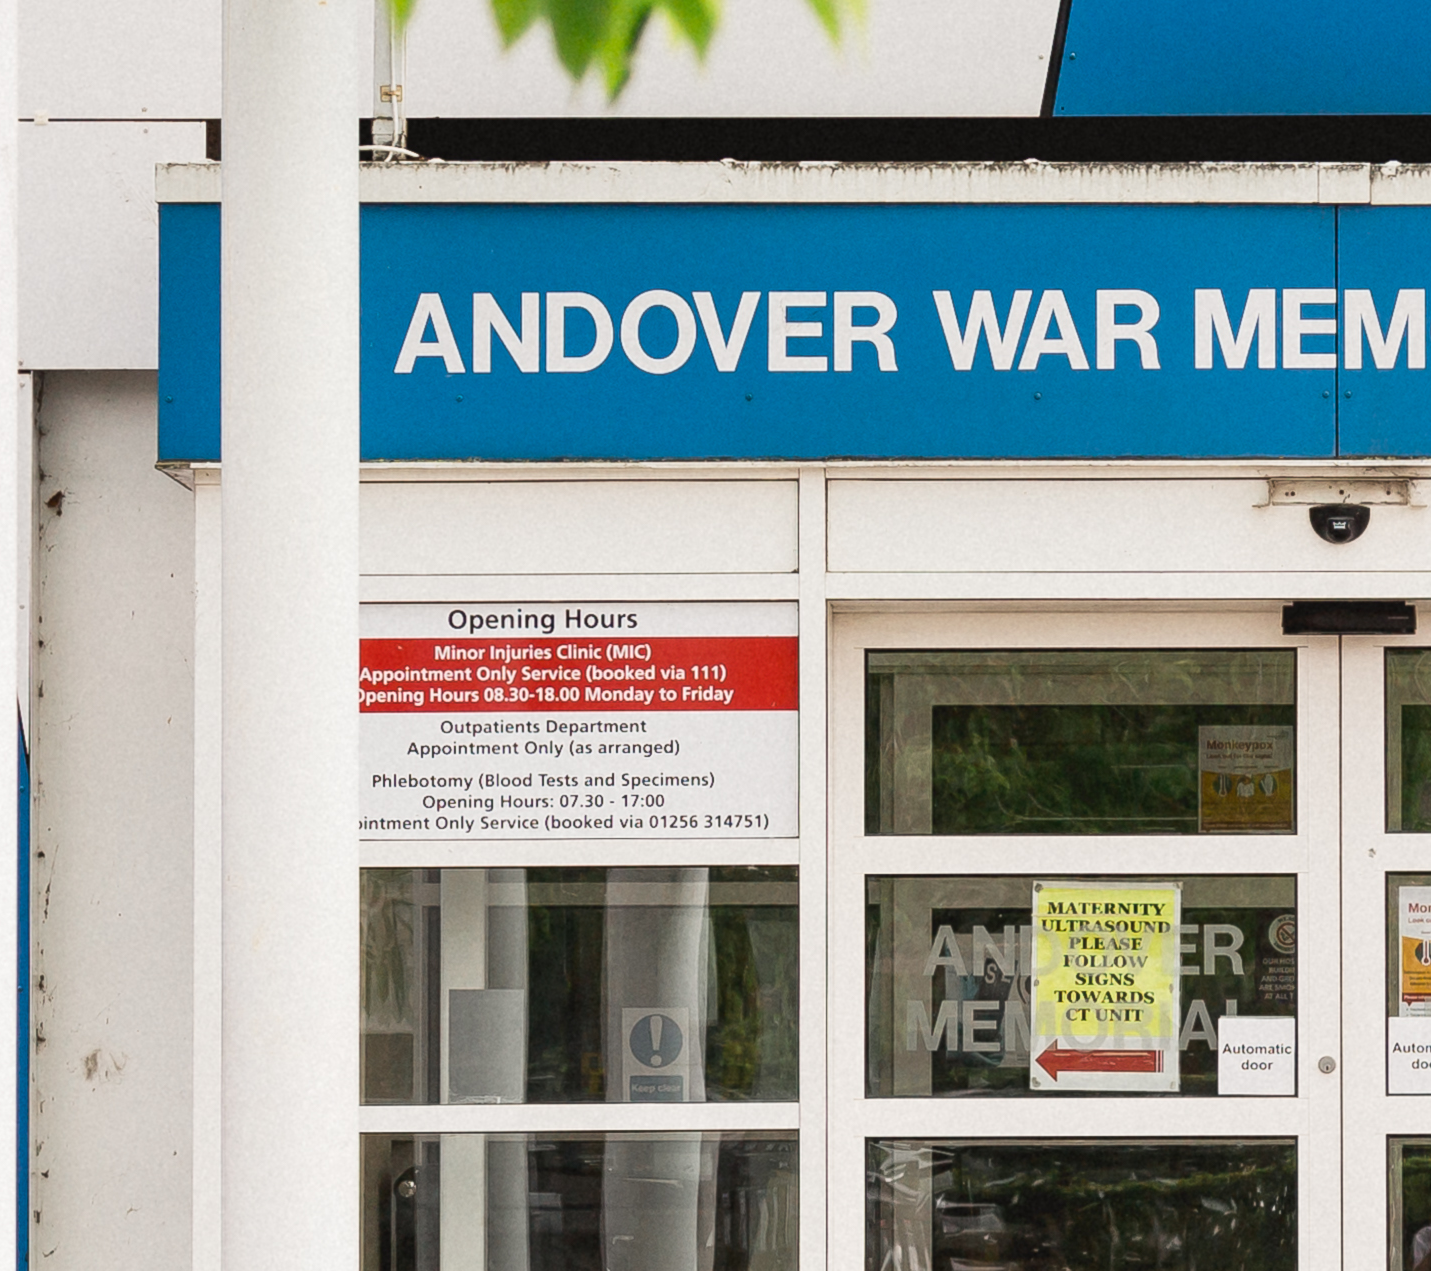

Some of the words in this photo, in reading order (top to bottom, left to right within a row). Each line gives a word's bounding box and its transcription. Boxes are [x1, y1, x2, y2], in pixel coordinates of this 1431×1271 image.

[393, 289, 898, 376] ANDOVER
[933, 289, 1161, 372] WAR
[448, 609, 555, 633] Opening
[565, 609, 638, 629] Hours
[434, 645, 485, 660] Minor
[490, 645, 552, 663] Injuries
[556, 644, 601, 660] Clinic
[606, 644, 651, 662] (MIC)
[360, 666, 472, 685] Appointment
[476, 666, 516, 684] Only
[522, 666, 581, 681] Service
[586, 665, 656, 682] (booked
[660, 665, 685, 680] via
[691, 664, 726, 682] 111)
[429, 688, 479, 702] Hours
[484, 687, 579, 702] 08.30-18.00
[585, 687, 655, 705] Monday
[658, 688, 677, 701] to
[682, 686, 733, 705] Friday
[441, 720, 540, 737] Outpatients
[546, 719, 646, 736] Department
[407, 741, 520, 758] Appointment
[525, 740, 563, 758] Only
[569, 740, 592, 757] (as
[598, 740, 680, 758] arranged)
[1207, 739, 1273, 752] Monkeypox
[372, 774, 473, 792] Phlebotomy
[478, 773, 532, 790] (Blood
[539, 773, 578, 787] Tests
[583, 772, 615, 787] and
[621, 772, 715, 790] Specimens)
[422, 795, 494, 812] Opening
[500, 794, 555, 808] Hours:
[559, 794, 604, 808] 07.30
[621, 794, 664, 808] 17:00
[435, 815, 475, 833] Only
[480, 815, 539, 830] Service
[544, 814, 613, 832] (booked
[619, 815, 643, 828] via
[649, 814, 698, 829] 01256
[704, 814, 769, 831] 314751)
[1047, 902, 1165, 916] MATERNITY
[1041, 920, 1170, 933] ULTRASOUND
[1069, 937, 1142, 950] PLEASE
[1063, 955, 1148, 968] FOLLOW
[1075, 973, 1134, 986] SIGNS
[1054, 990, 1155, 1004] TOWARDS
[1066, 1008, 1090, 1021] CT
[1095, 1008, 1144, 1021] UNIT
[1222, 1043, 1292, 1054] Automatic
[1241, 1060, 1273, 1070] door
[632, 1084, 656, 1094] Keep
